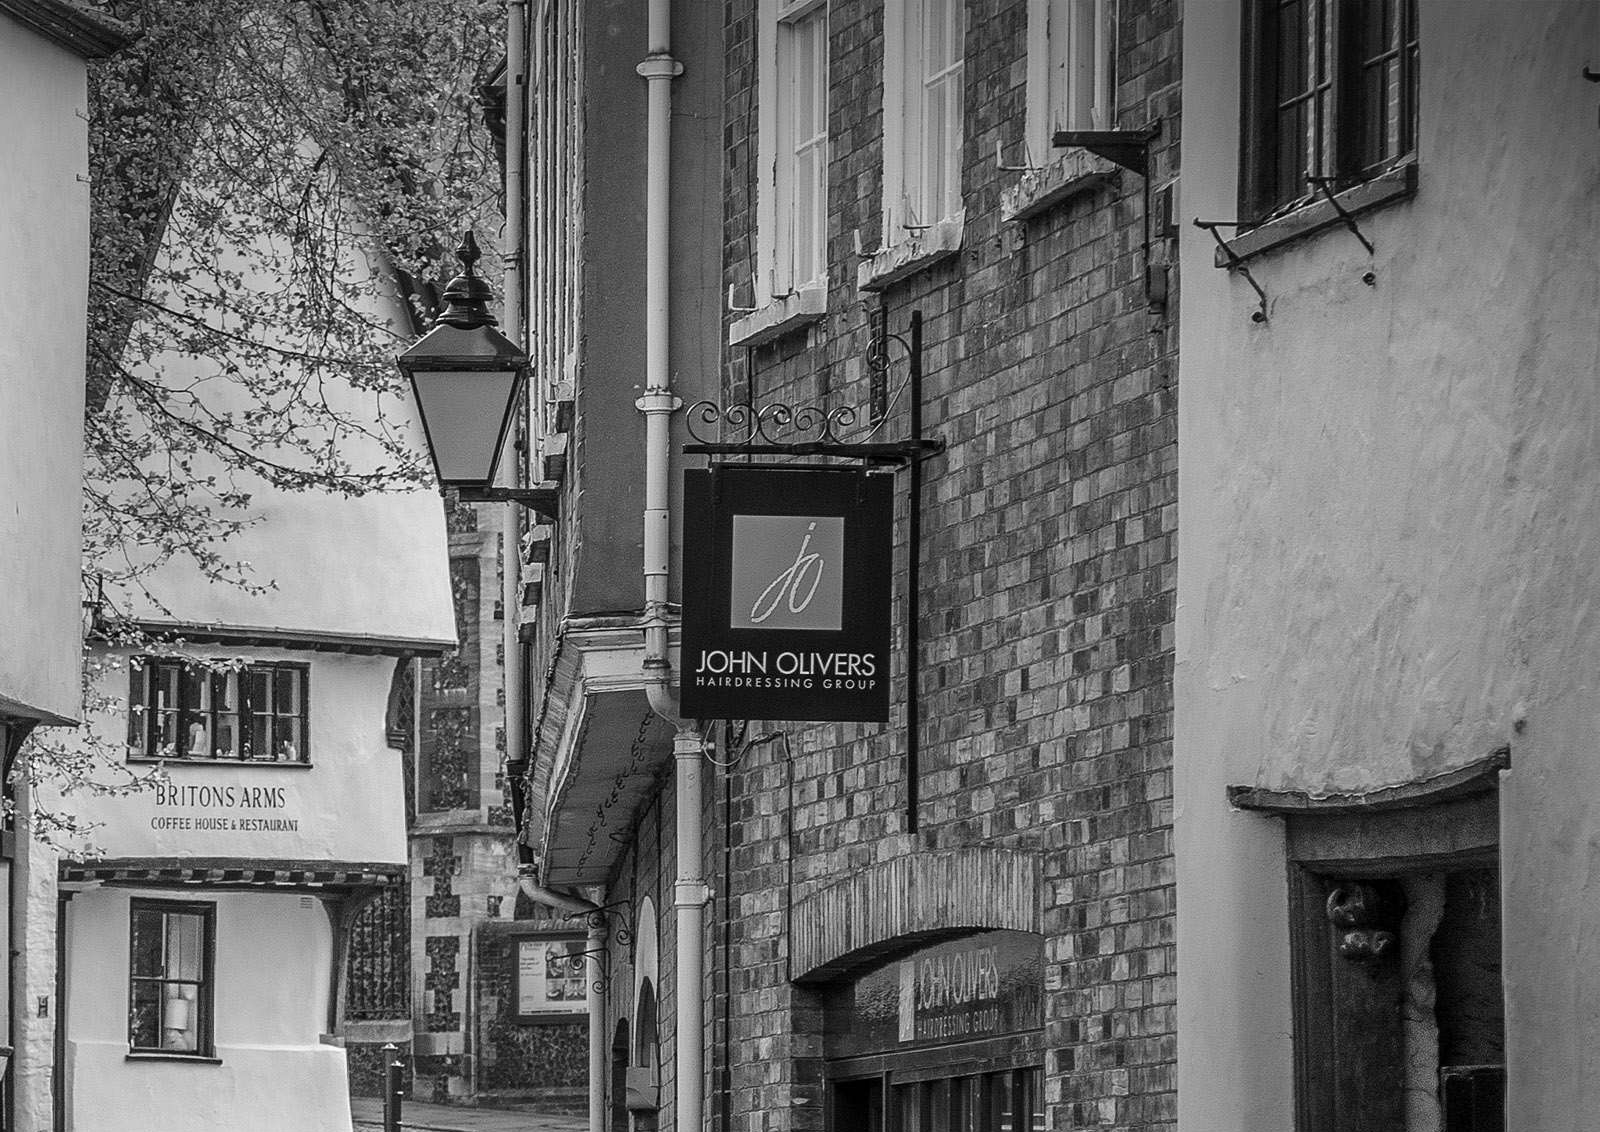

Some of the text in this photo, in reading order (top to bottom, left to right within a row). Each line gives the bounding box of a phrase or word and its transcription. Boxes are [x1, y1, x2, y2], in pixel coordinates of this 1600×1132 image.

[696, 650, 876, 677] JOHN OLIVERS
[696, 676, 876, 690] HAIRDRESSING GROUP
[156, 784, 286, 808] BRITONS ARMS
[151, 816, 299, 832] COFFEE HOUSE & RESTAURANT
[917, 946, 999, 1010] JOHN OLIVERS
